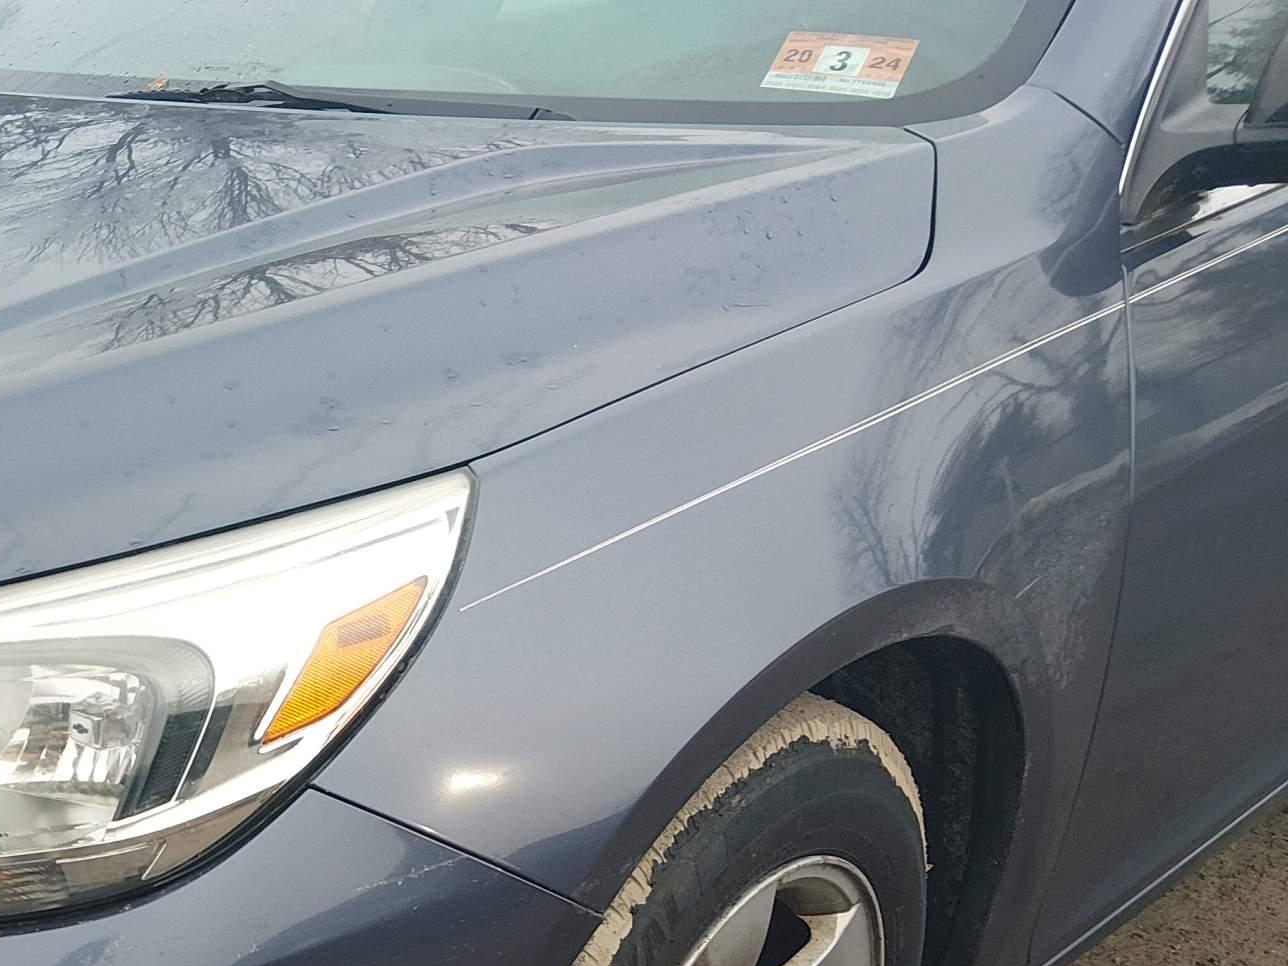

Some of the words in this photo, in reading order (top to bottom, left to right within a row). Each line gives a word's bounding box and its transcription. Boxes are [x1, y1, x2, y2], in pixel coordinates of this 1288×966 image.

[784, 49, 812, 63] 20
[830, 51, 852, 71] 3
[870, 57, 901, 71] 24
